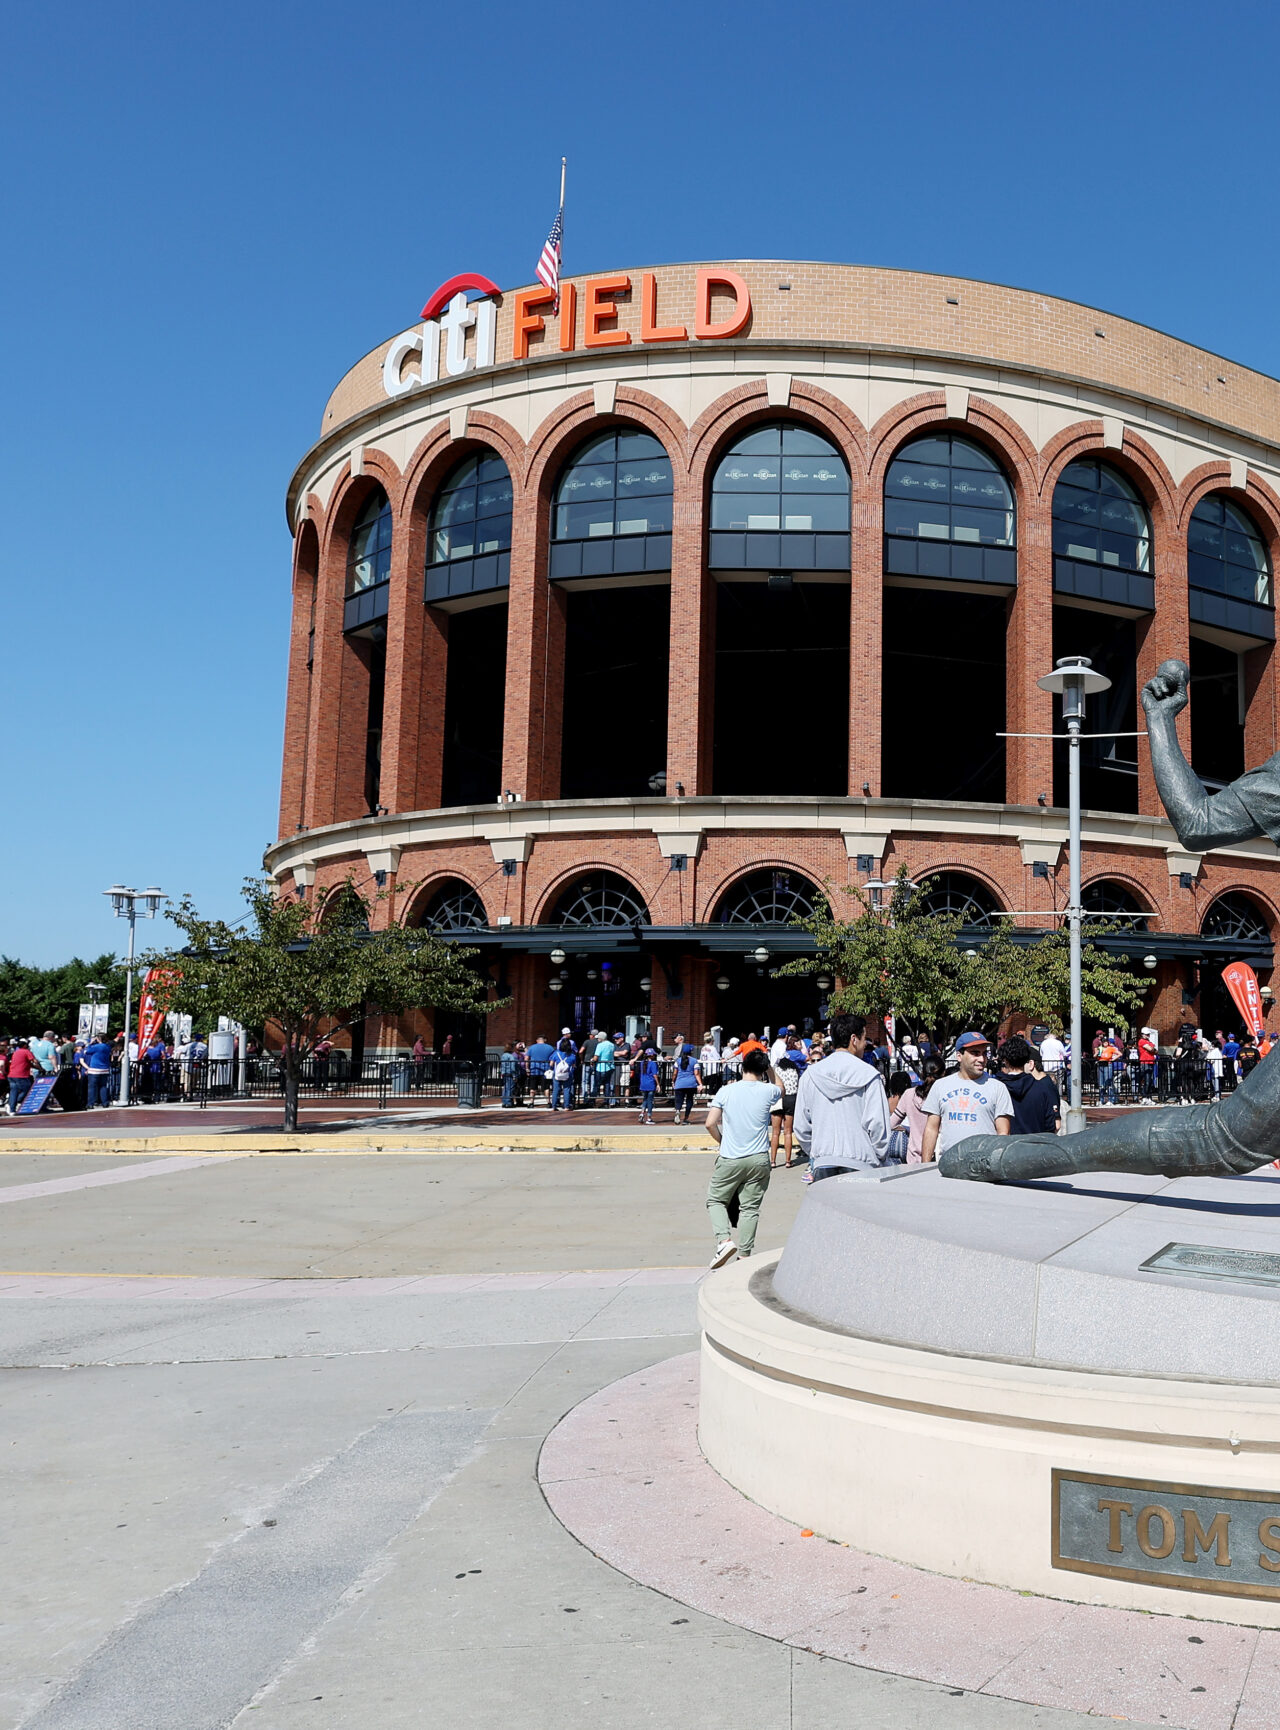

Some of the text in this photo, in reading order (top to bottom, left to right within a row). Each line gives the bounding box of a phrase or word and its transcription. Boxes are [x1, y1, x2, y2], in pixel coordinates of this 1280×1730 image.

[383, 269, 752, 398] citi FIELD
[942, 1088, 987, 1104] LET'S GO
[949, 1112, 977, 1122] METS
[1098, 1499, 1232, 1567] TOM
